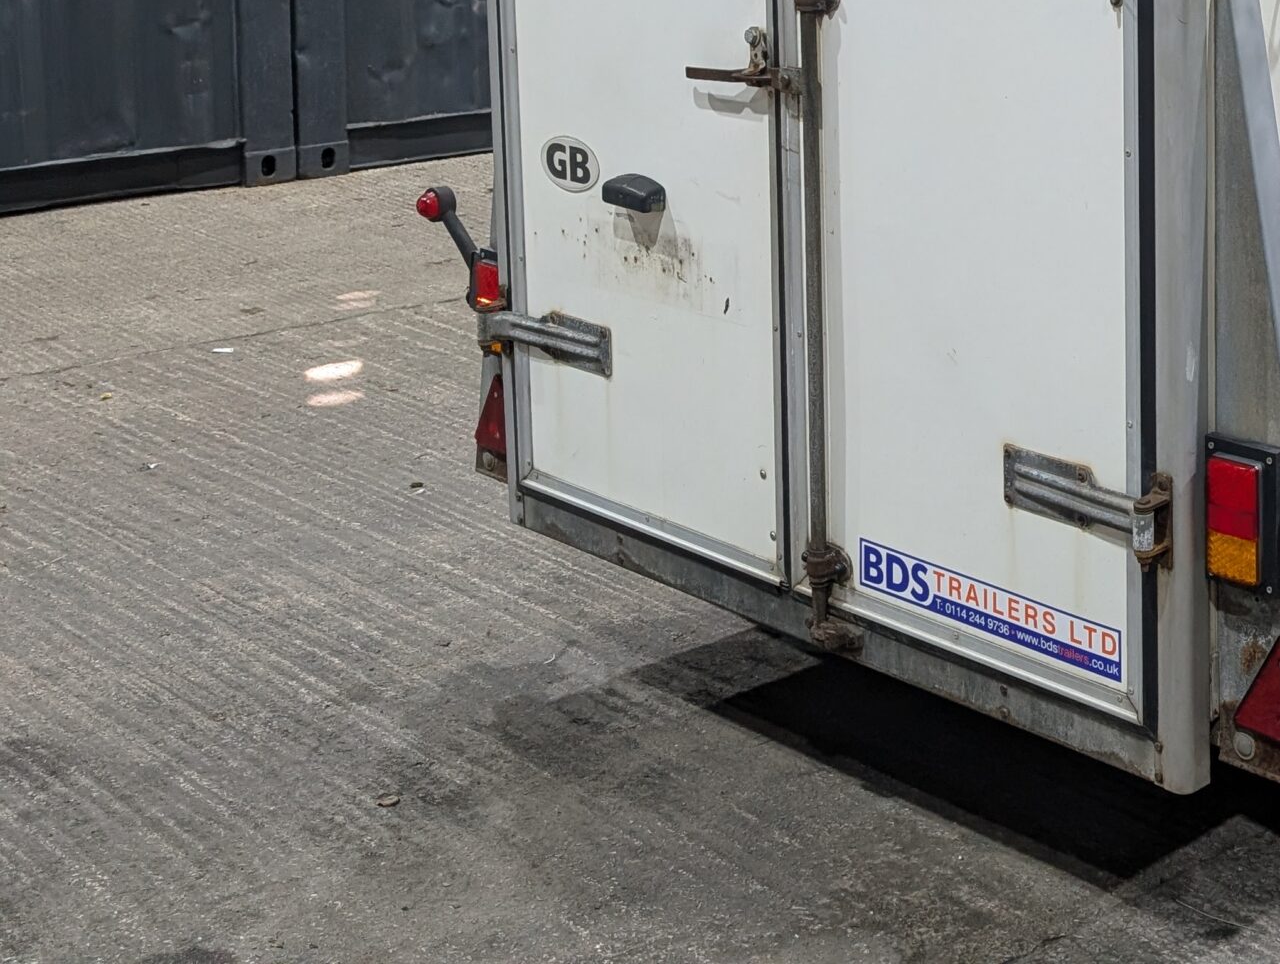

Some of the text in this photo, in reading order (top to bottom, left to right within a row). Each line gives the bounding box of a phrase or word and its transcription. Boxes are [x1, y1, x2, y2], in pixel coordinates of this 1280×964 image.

[546, 142, 591, 185] GB
[863, 544, 1118, 656] BDS TRAILERS LTD
[935, 598, 1120, 676] T: 0114 244 9736 www.bdstrailers.co.uk
